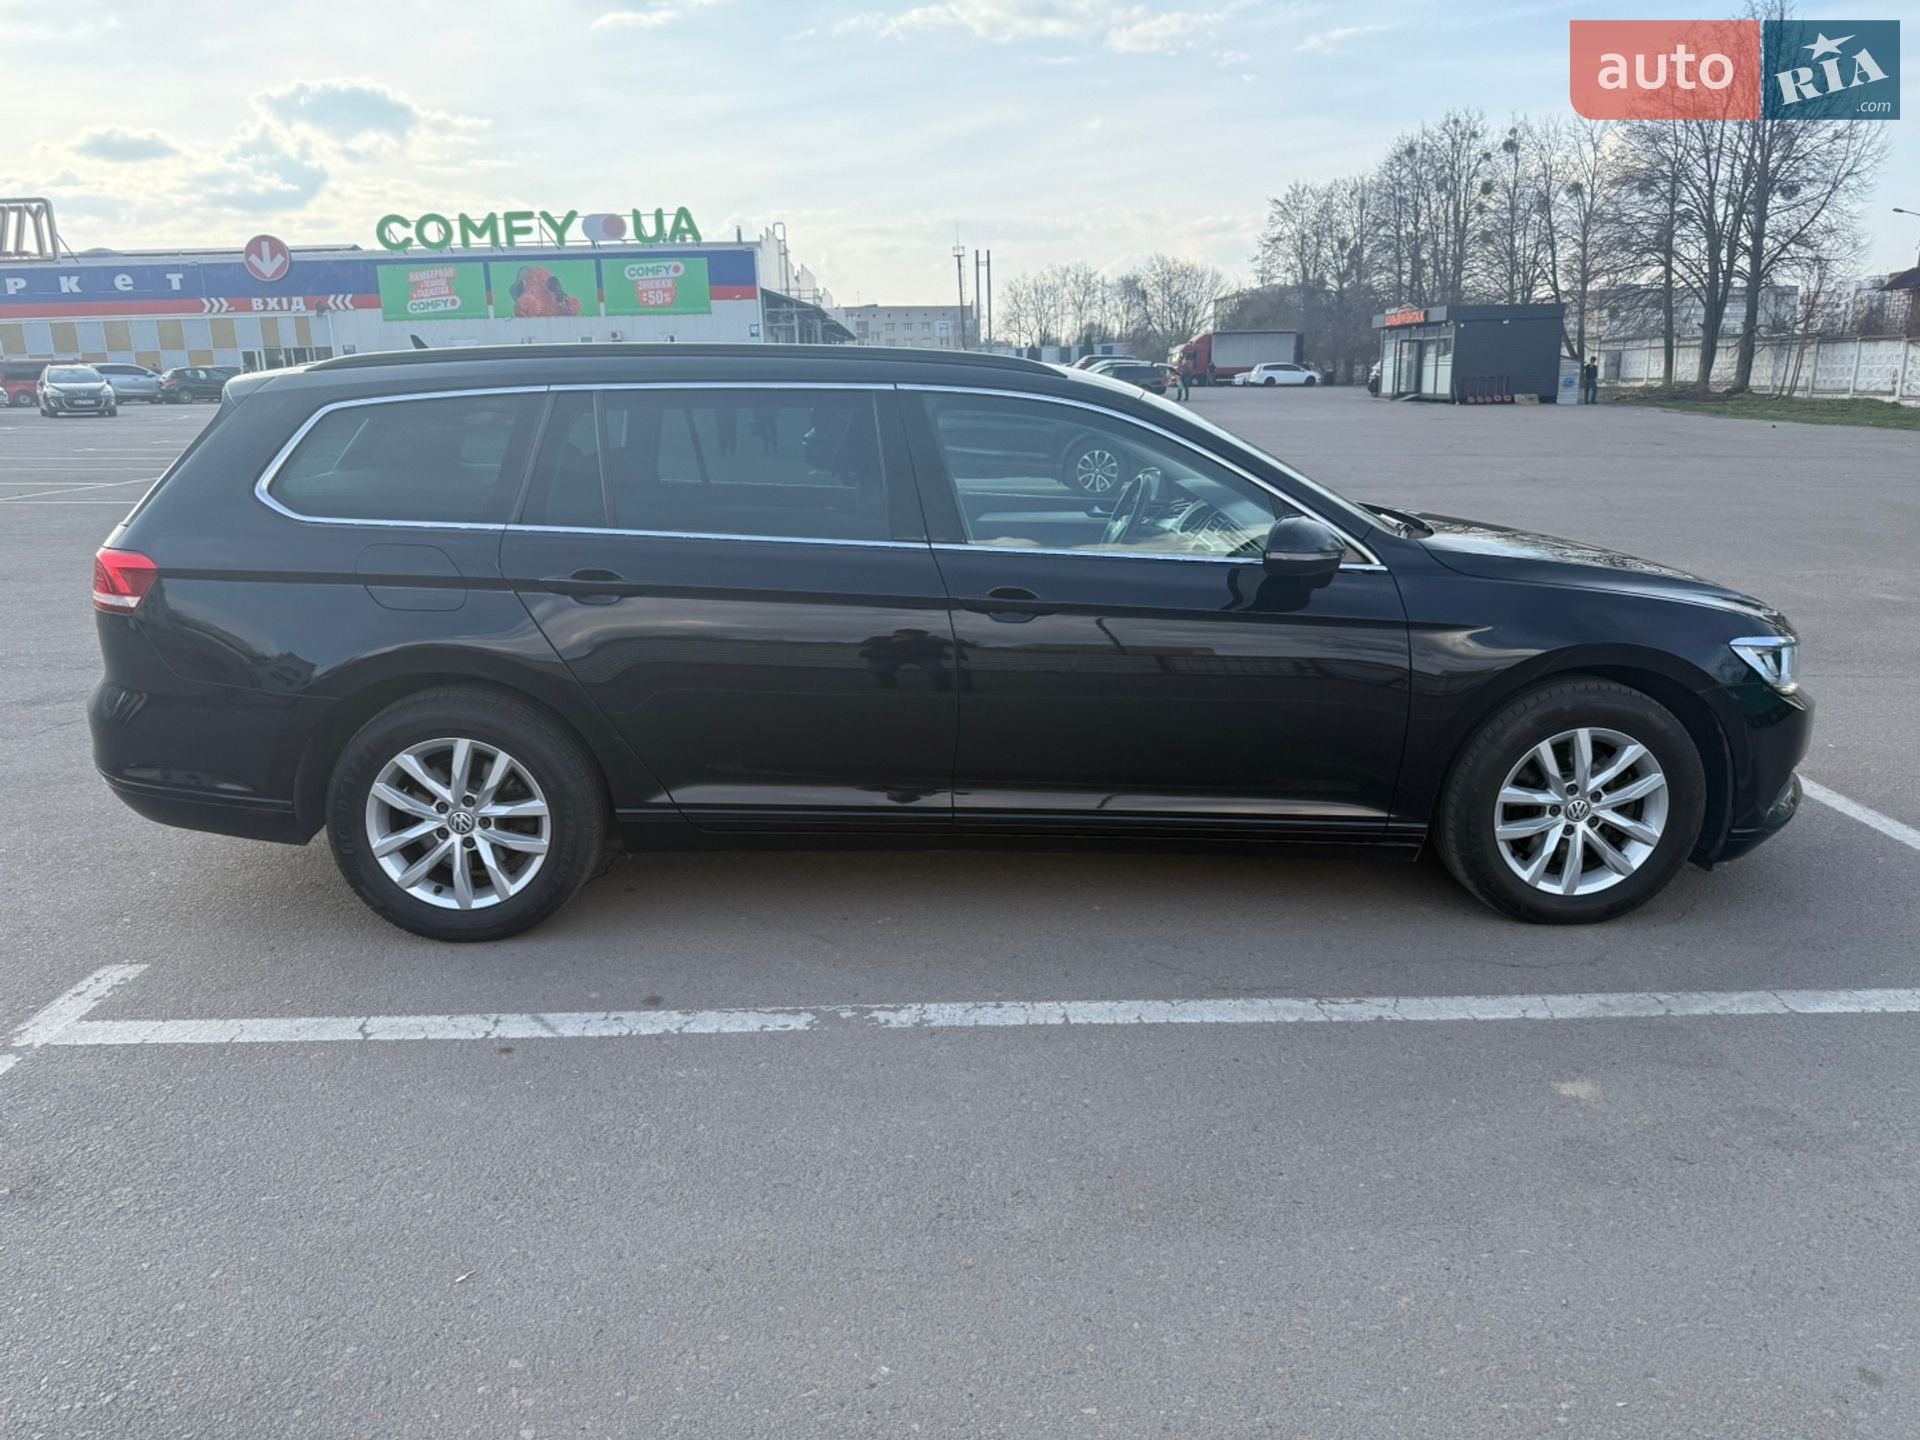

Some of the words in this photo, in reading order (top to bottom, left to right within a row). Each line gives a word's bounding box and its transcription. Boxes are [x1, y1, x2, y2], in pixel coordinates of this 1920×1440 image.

[376, 209, 578, 250] COMFY
[632, 206, 702, 243] UA
[627, 264, 671, 277] COMFY
[251, 296, 306, 312] ВХІД
[410, 299, 449, 311] COMFY
